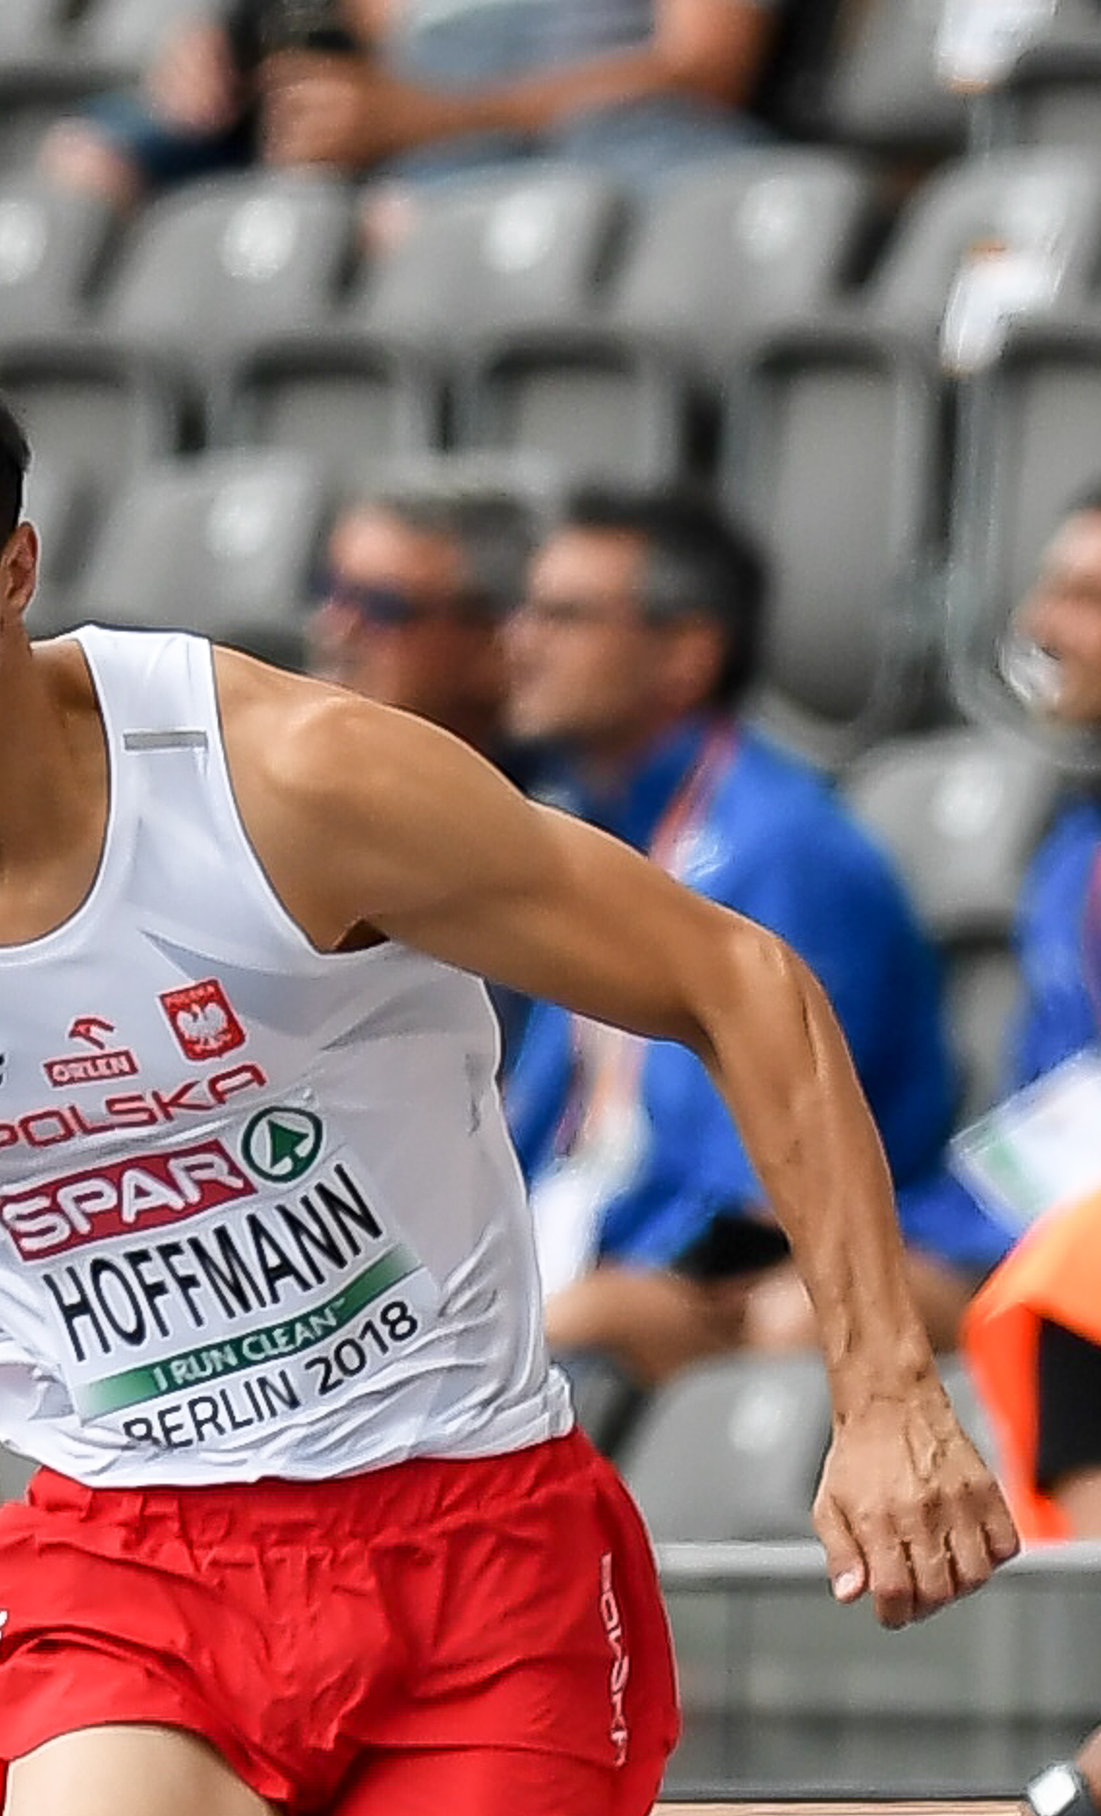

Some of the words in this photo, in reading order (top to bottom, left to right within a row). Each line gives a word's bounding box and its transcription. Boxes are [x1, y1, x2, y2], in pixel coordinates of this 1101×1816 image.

[52, 1054, 131, 1082] ORLEN
[1, 1154, 245, 1253] SPAR
[43, 1163, 384, 1363] HOFFMANN
[123, 1369, 302, 1448] BERLIN
[303, 1300, 419, 1396] 2018
[151, 1367, 167, 1391] I
[169, 1345, 238, 1386] RUN
[241, 1312, 339, 1364] CLEAN
